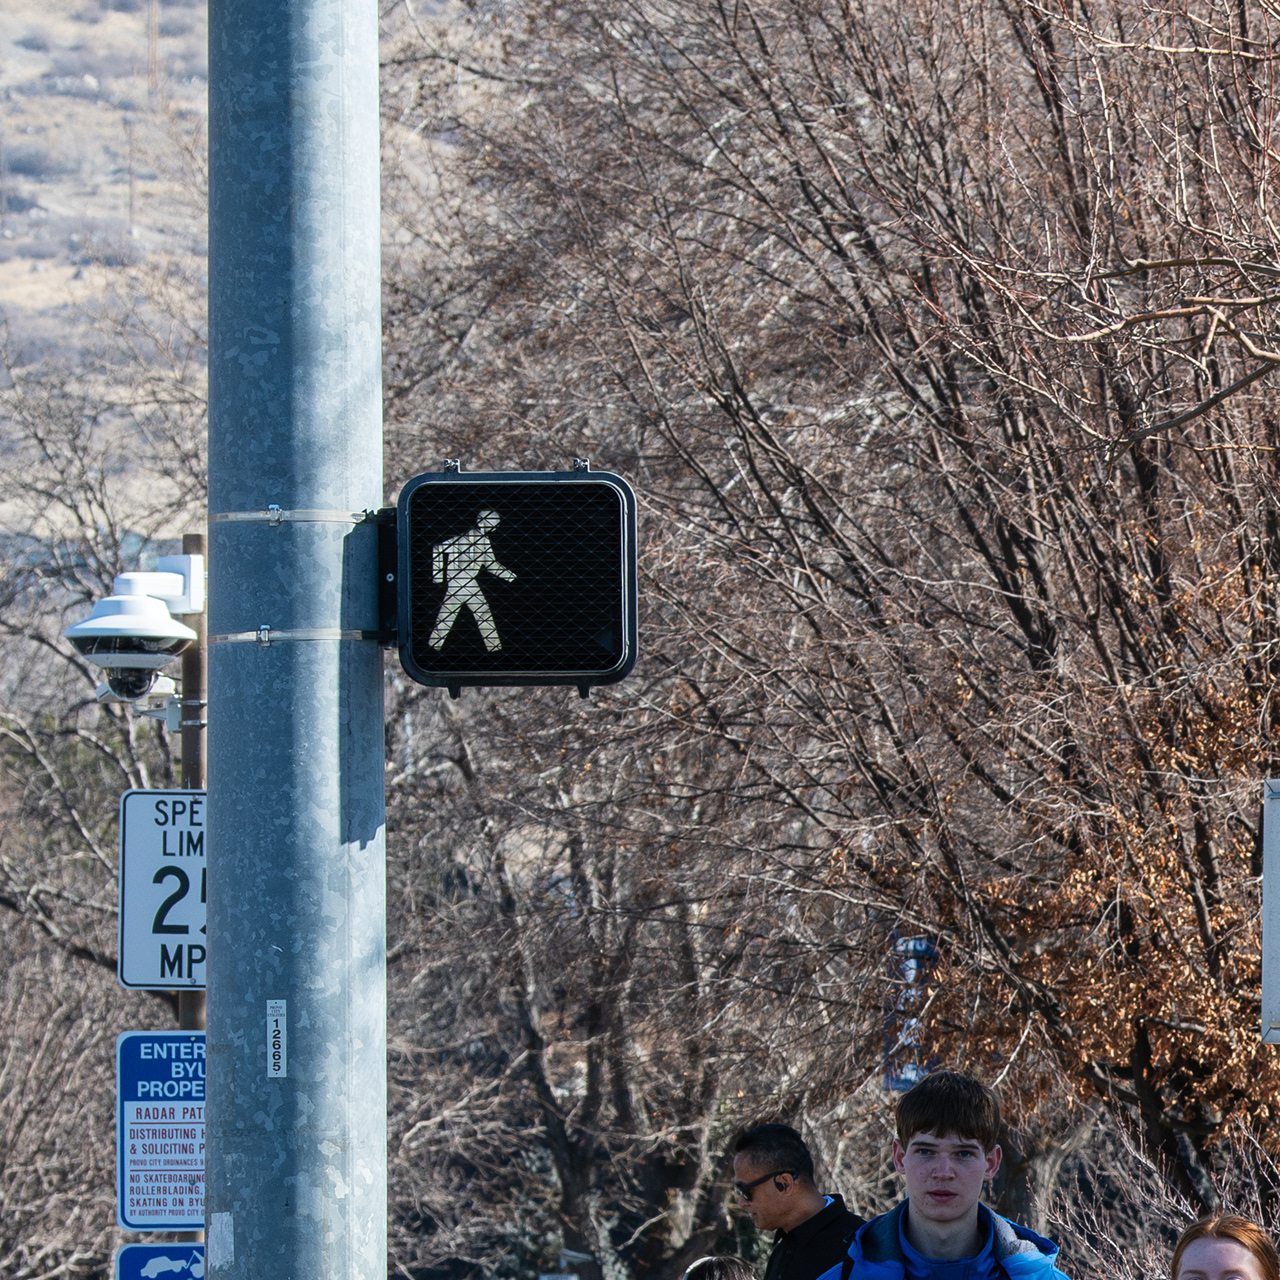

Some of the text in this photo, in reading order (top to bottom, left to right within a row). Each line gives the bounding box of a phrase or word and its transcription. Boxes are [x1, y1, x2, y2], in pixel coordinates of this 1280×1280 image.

[154, 800, 203, 826] SPE
[162, 830, 204, 857] LIM
[152, 865, 207, 935] 2
[160, 943, 206, 979] MP
[140, 1043, 206, 1059] ENTER
[272, 1018, 281, 1072] 12665
[137, 1081, 205, 1097] PROPE
[136, 1107, 205, 1120] RADAR PAT
[129, 1128, 197, 1140] DISTRIBUTING
[129, 1143, 137, 1155] &
[141, 1143, 195, 1155] SOLICITING
[163, 1158, 198, 1166] ORDINANCES
[129, 1174, 141, 1183] NO
[129, 1197, 168, 1207] SKATING
[172, 1197, 184, 1207] ON
[129, 1209, 136, 1217] BY
[168, 1209, 185, 1217] PROVO
[187, 1209, 199, 1217] CITY
